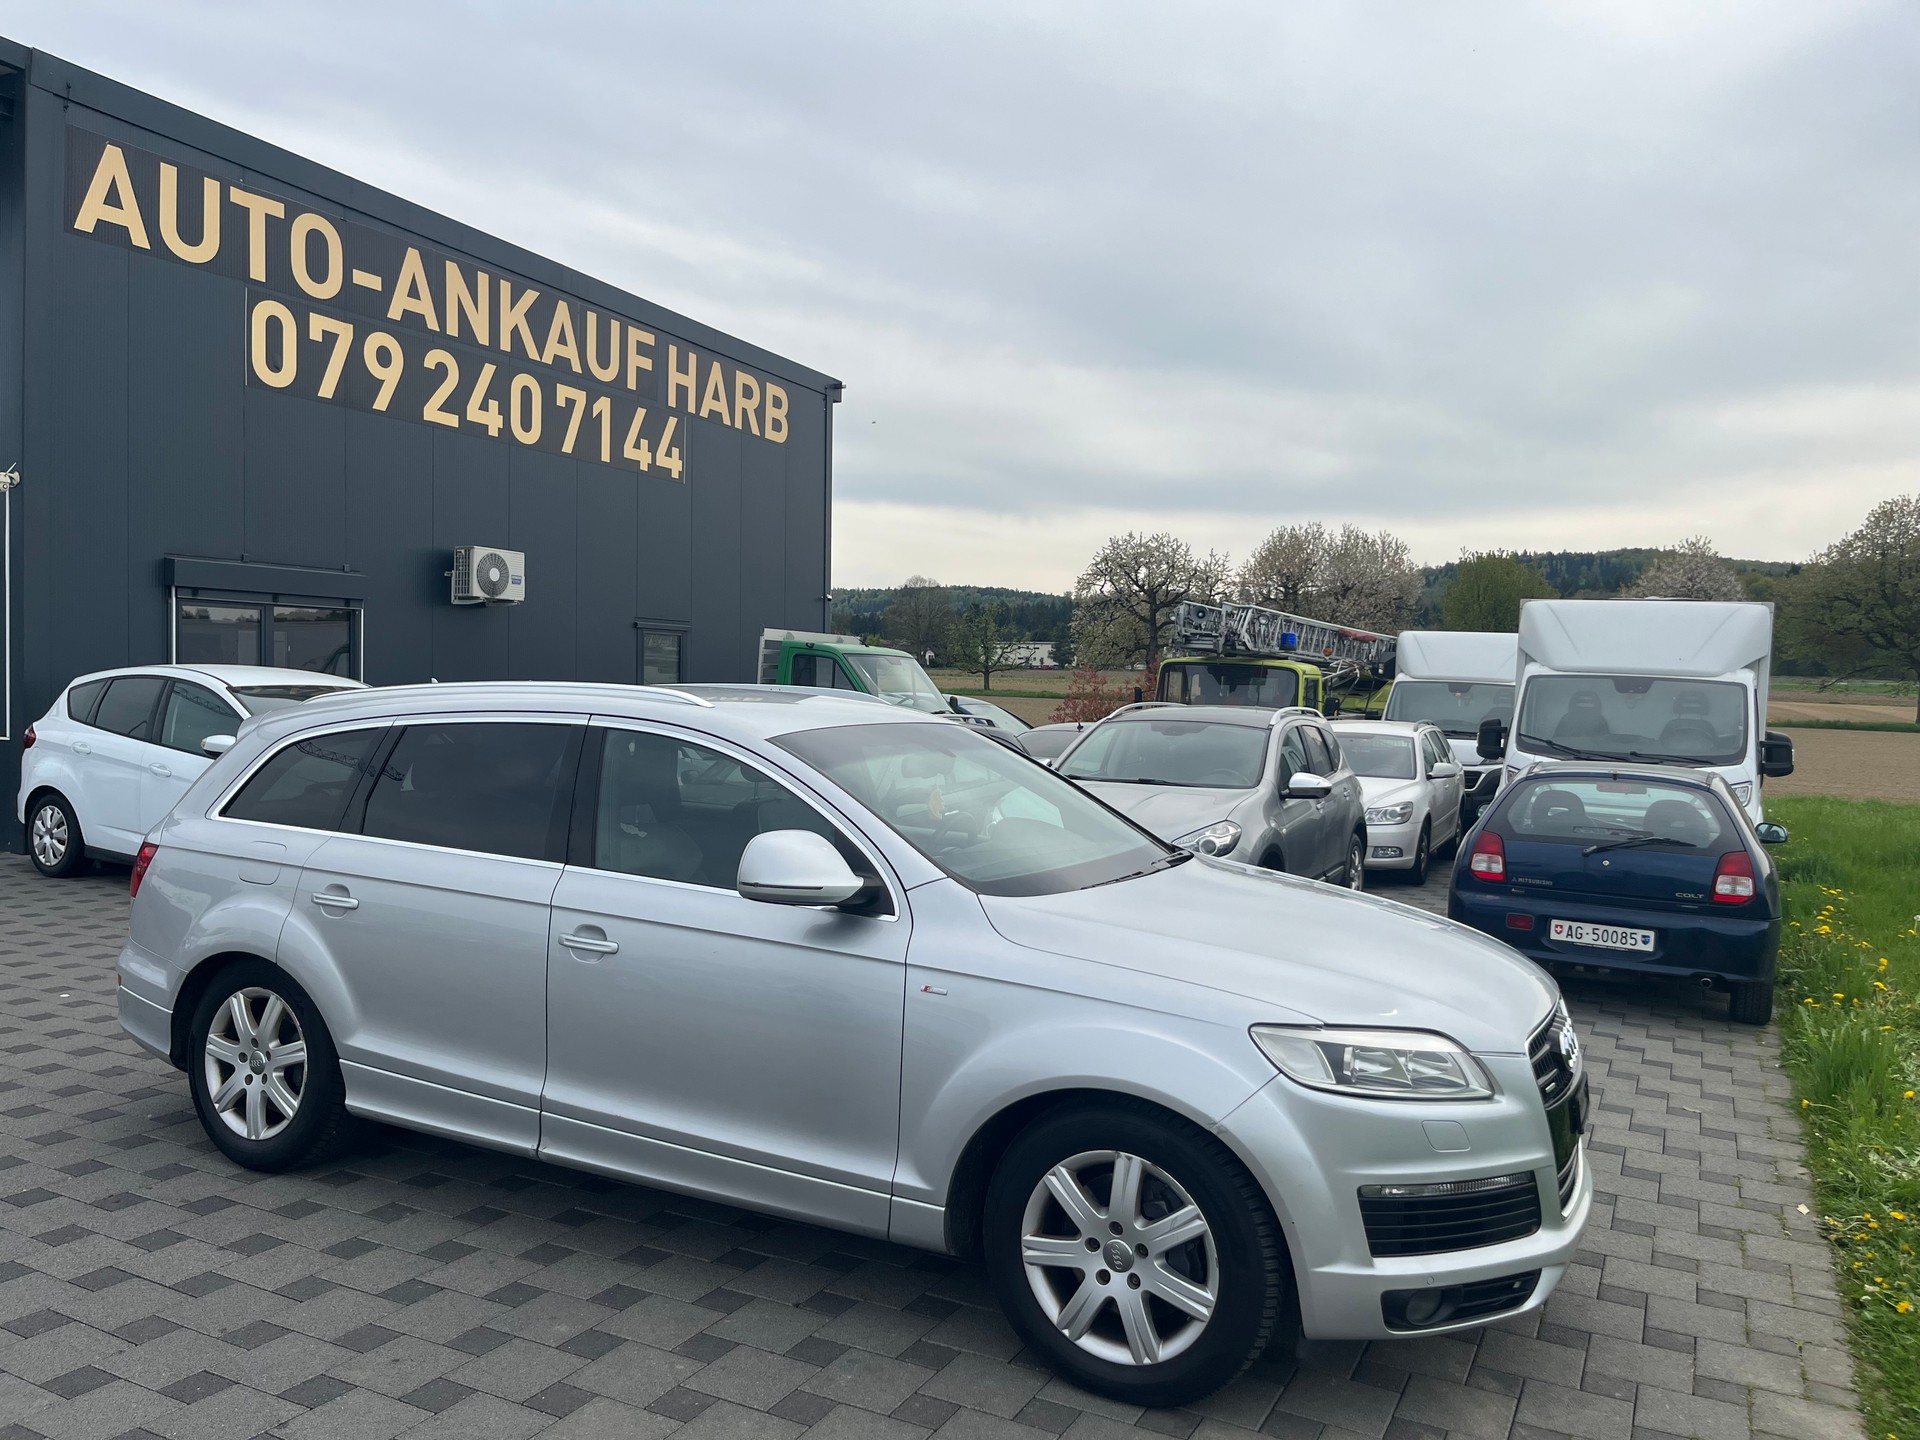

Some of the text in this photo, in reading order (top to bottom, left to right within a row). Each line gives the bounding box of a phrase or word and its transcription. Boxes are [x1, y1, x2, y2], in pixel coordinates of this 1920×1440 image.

[73, 143, 789, 444] AUTO-ANKAUF HARB
[251, 300, 683, 479] 079 240 7144
